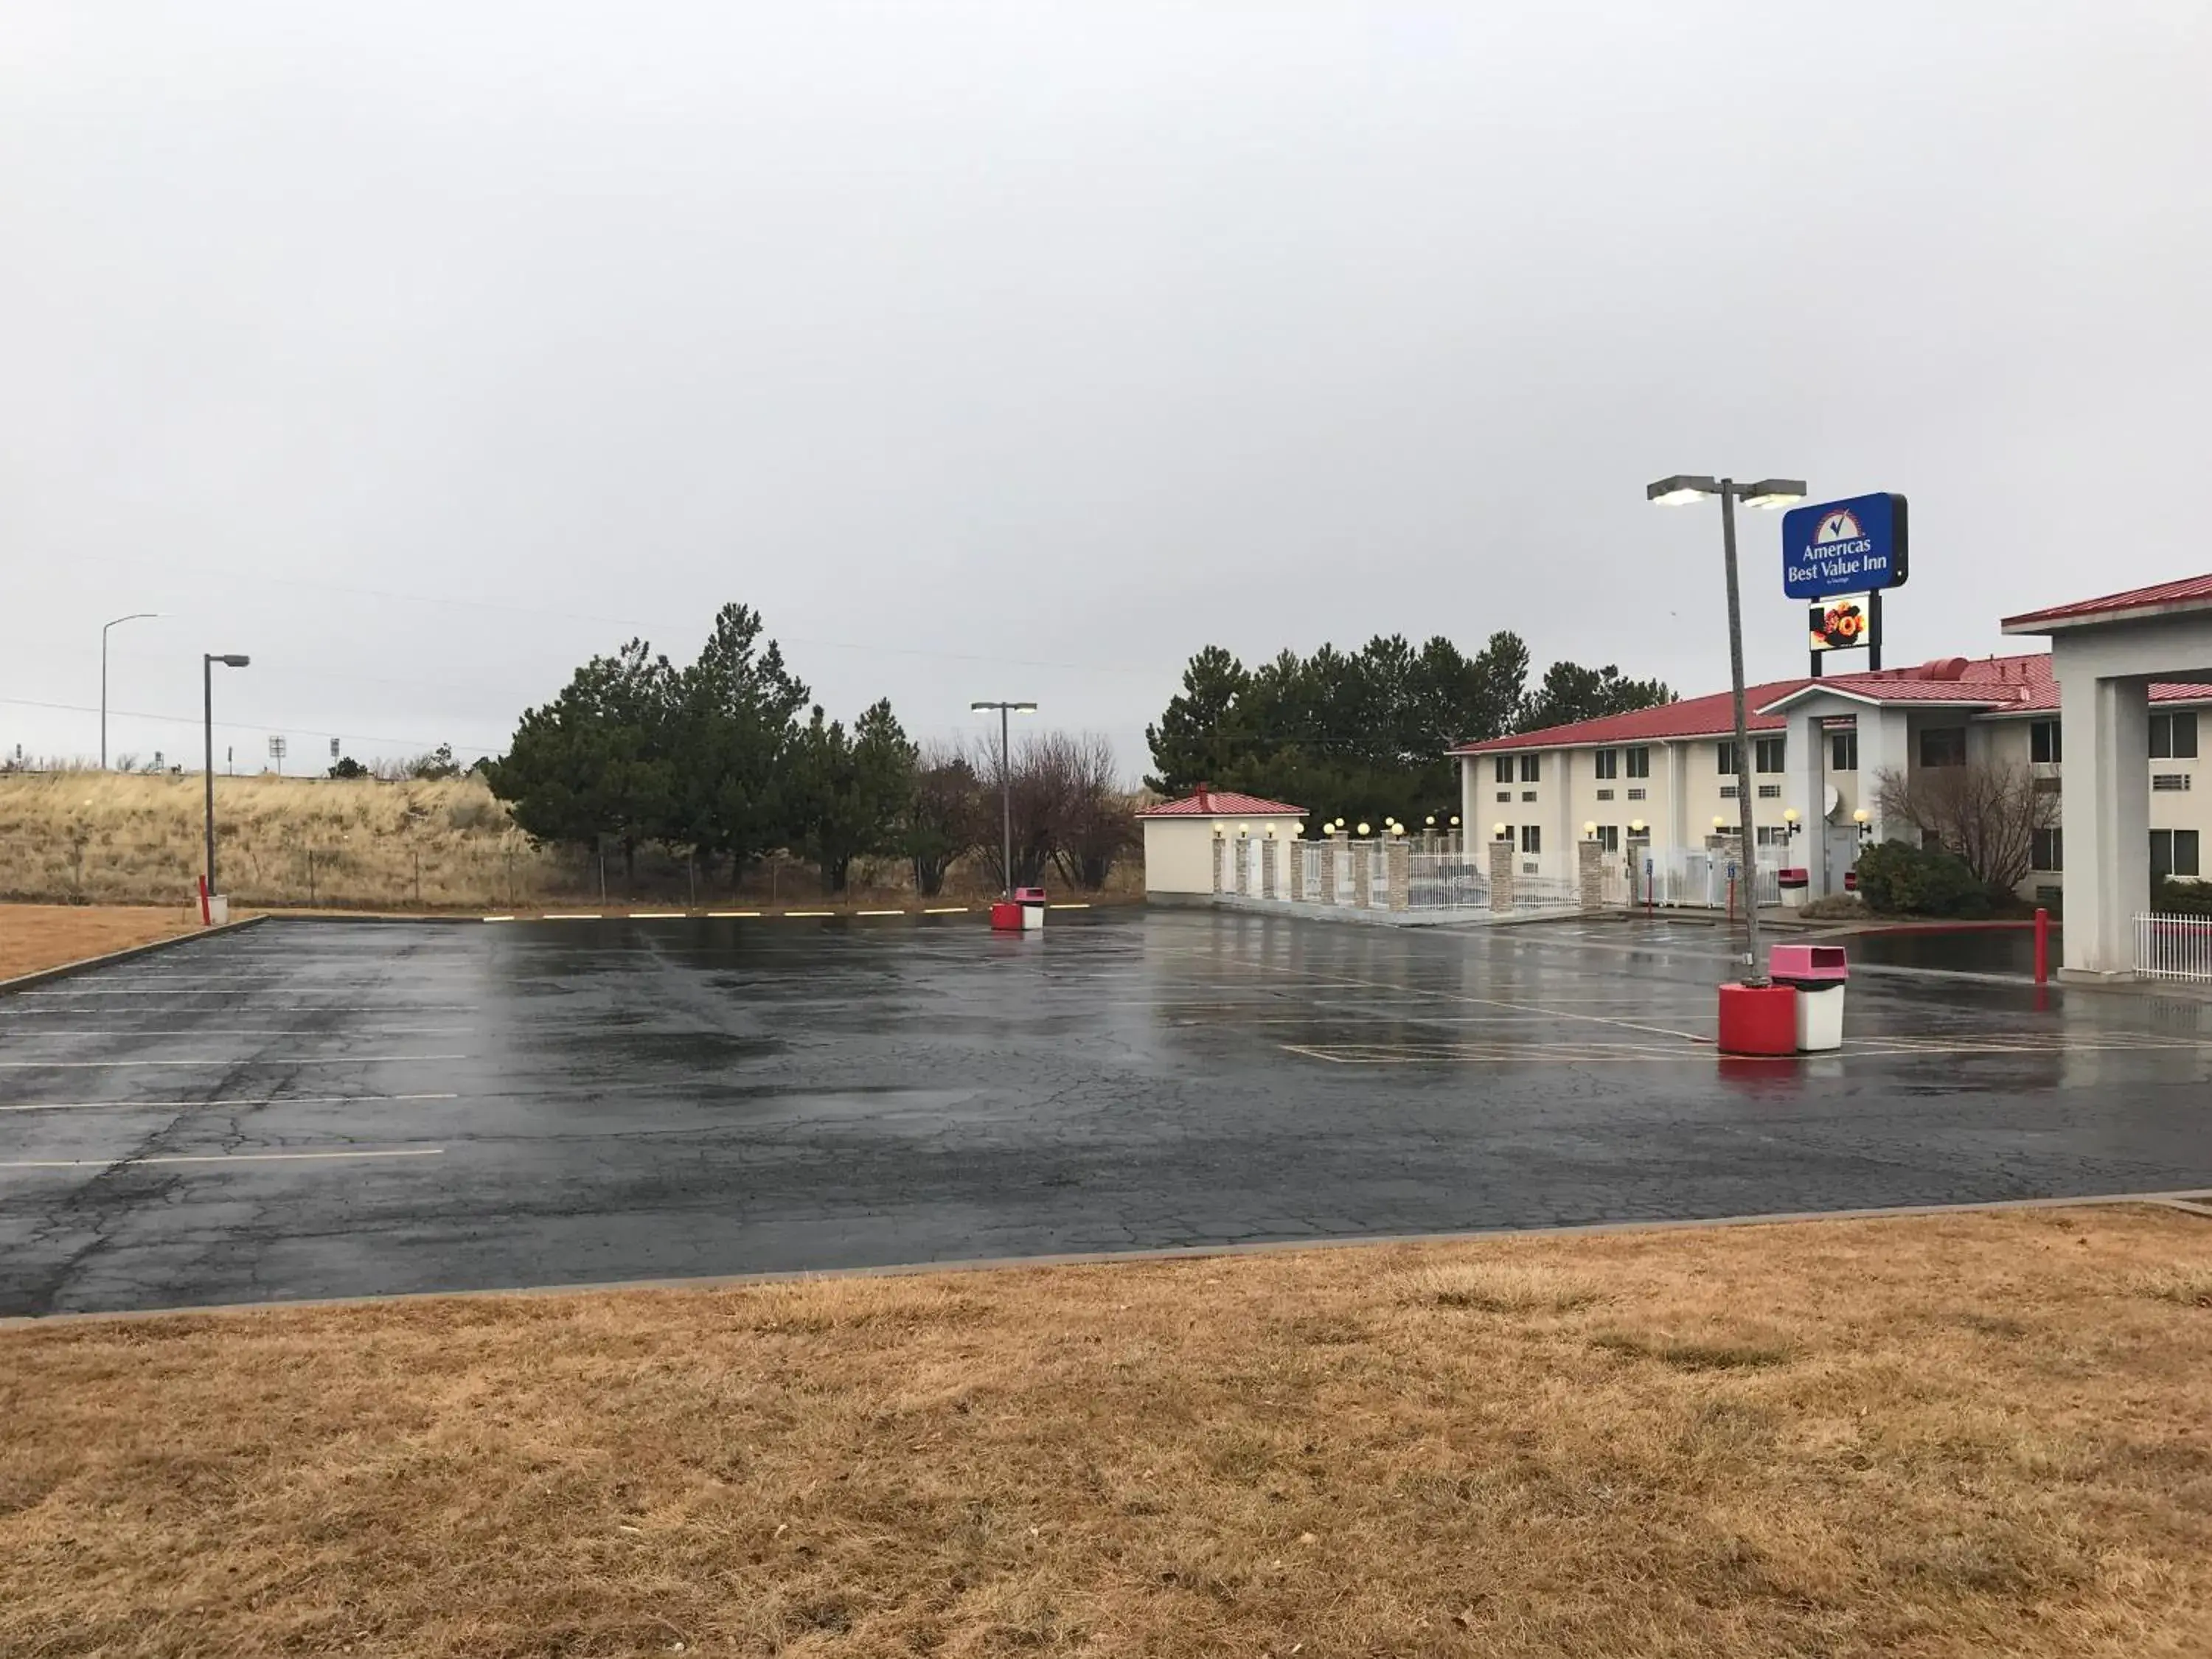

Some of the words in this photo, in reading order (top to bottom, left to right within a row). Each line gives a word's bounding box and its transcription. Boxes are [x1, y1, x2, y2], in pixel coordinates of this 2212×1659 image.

[1803, 539, 1871, 560] Americas
[1788, 566, 1818, 582] Best
[1821, 557, 1860, 577] Value
[1863, 555, 1887, 571] Inn
